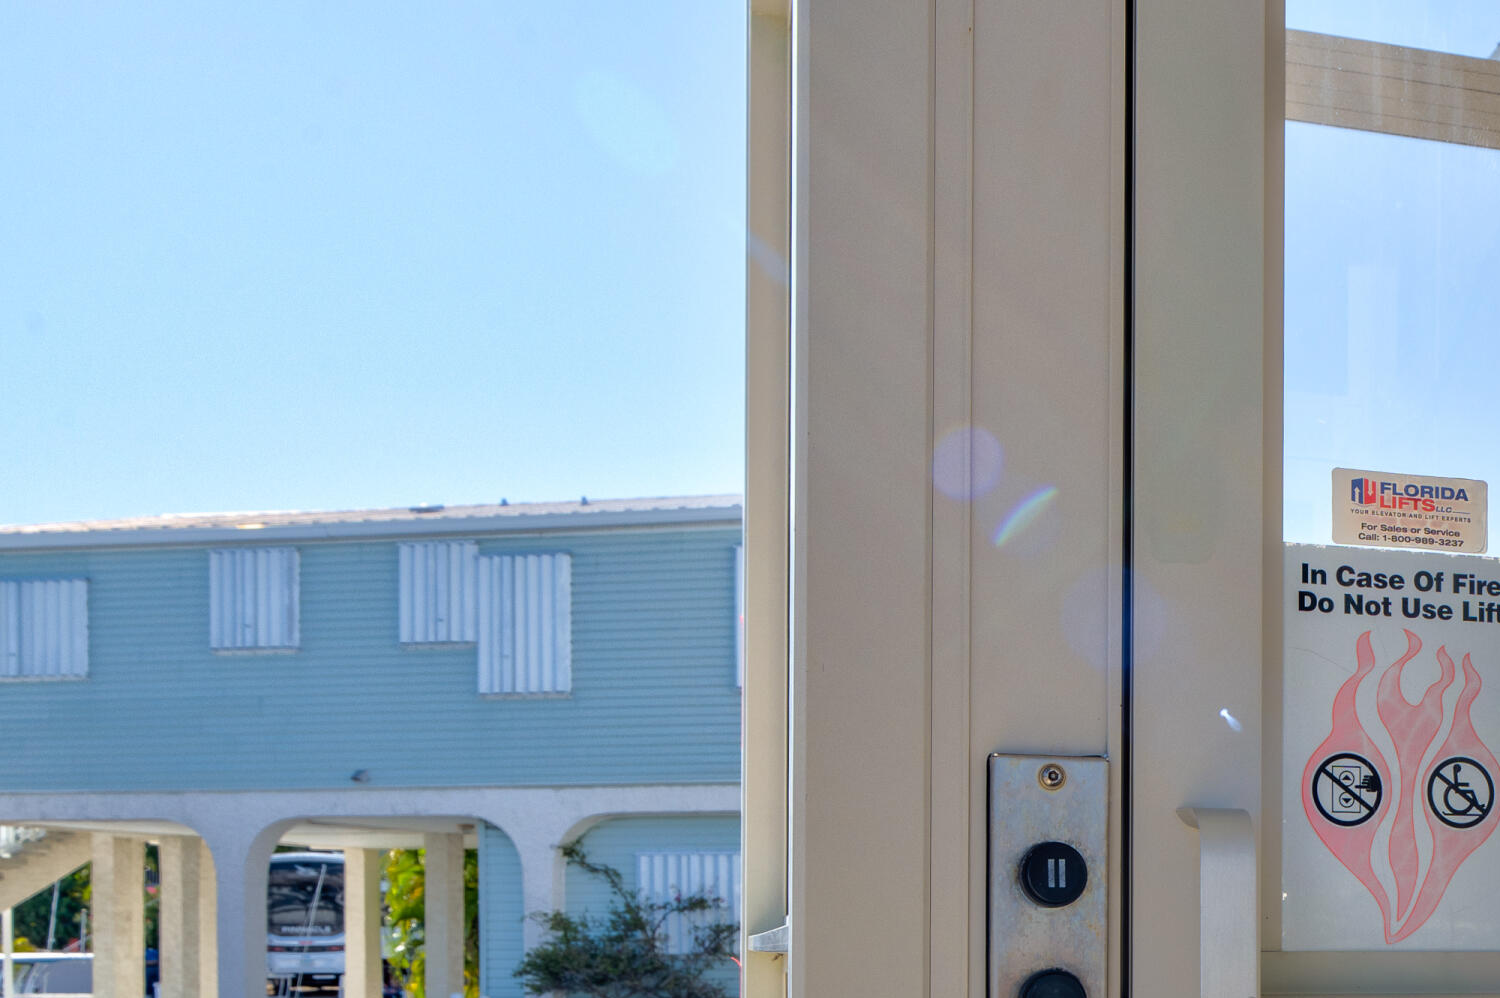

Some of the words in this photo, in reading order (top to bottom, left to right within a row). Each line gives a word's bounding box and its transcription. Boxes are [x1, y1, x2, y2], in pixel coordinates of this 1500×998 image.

[1380, 482, 1468, 501] FLORIDA
[1380, 495, 1435, 512] LIFTS
[1372, 510, 1406, 518] ELEVATOR
[1359, 533, 1379, 541] Call:
[1361, 522, 1377, 530] For
[1381, 524, 1407, 533] Sales
[1424, 528, 1460, 537] Service
[1302, 563, 1326, 585] In
[1336, 565, 1404, 589] Case
[1414, 571, 1444, 592] Of
[1298, 591, 1334, 613] Do
[1344, 593, 1392, 616] Not
[1402, 598, 1453, 620] Use
